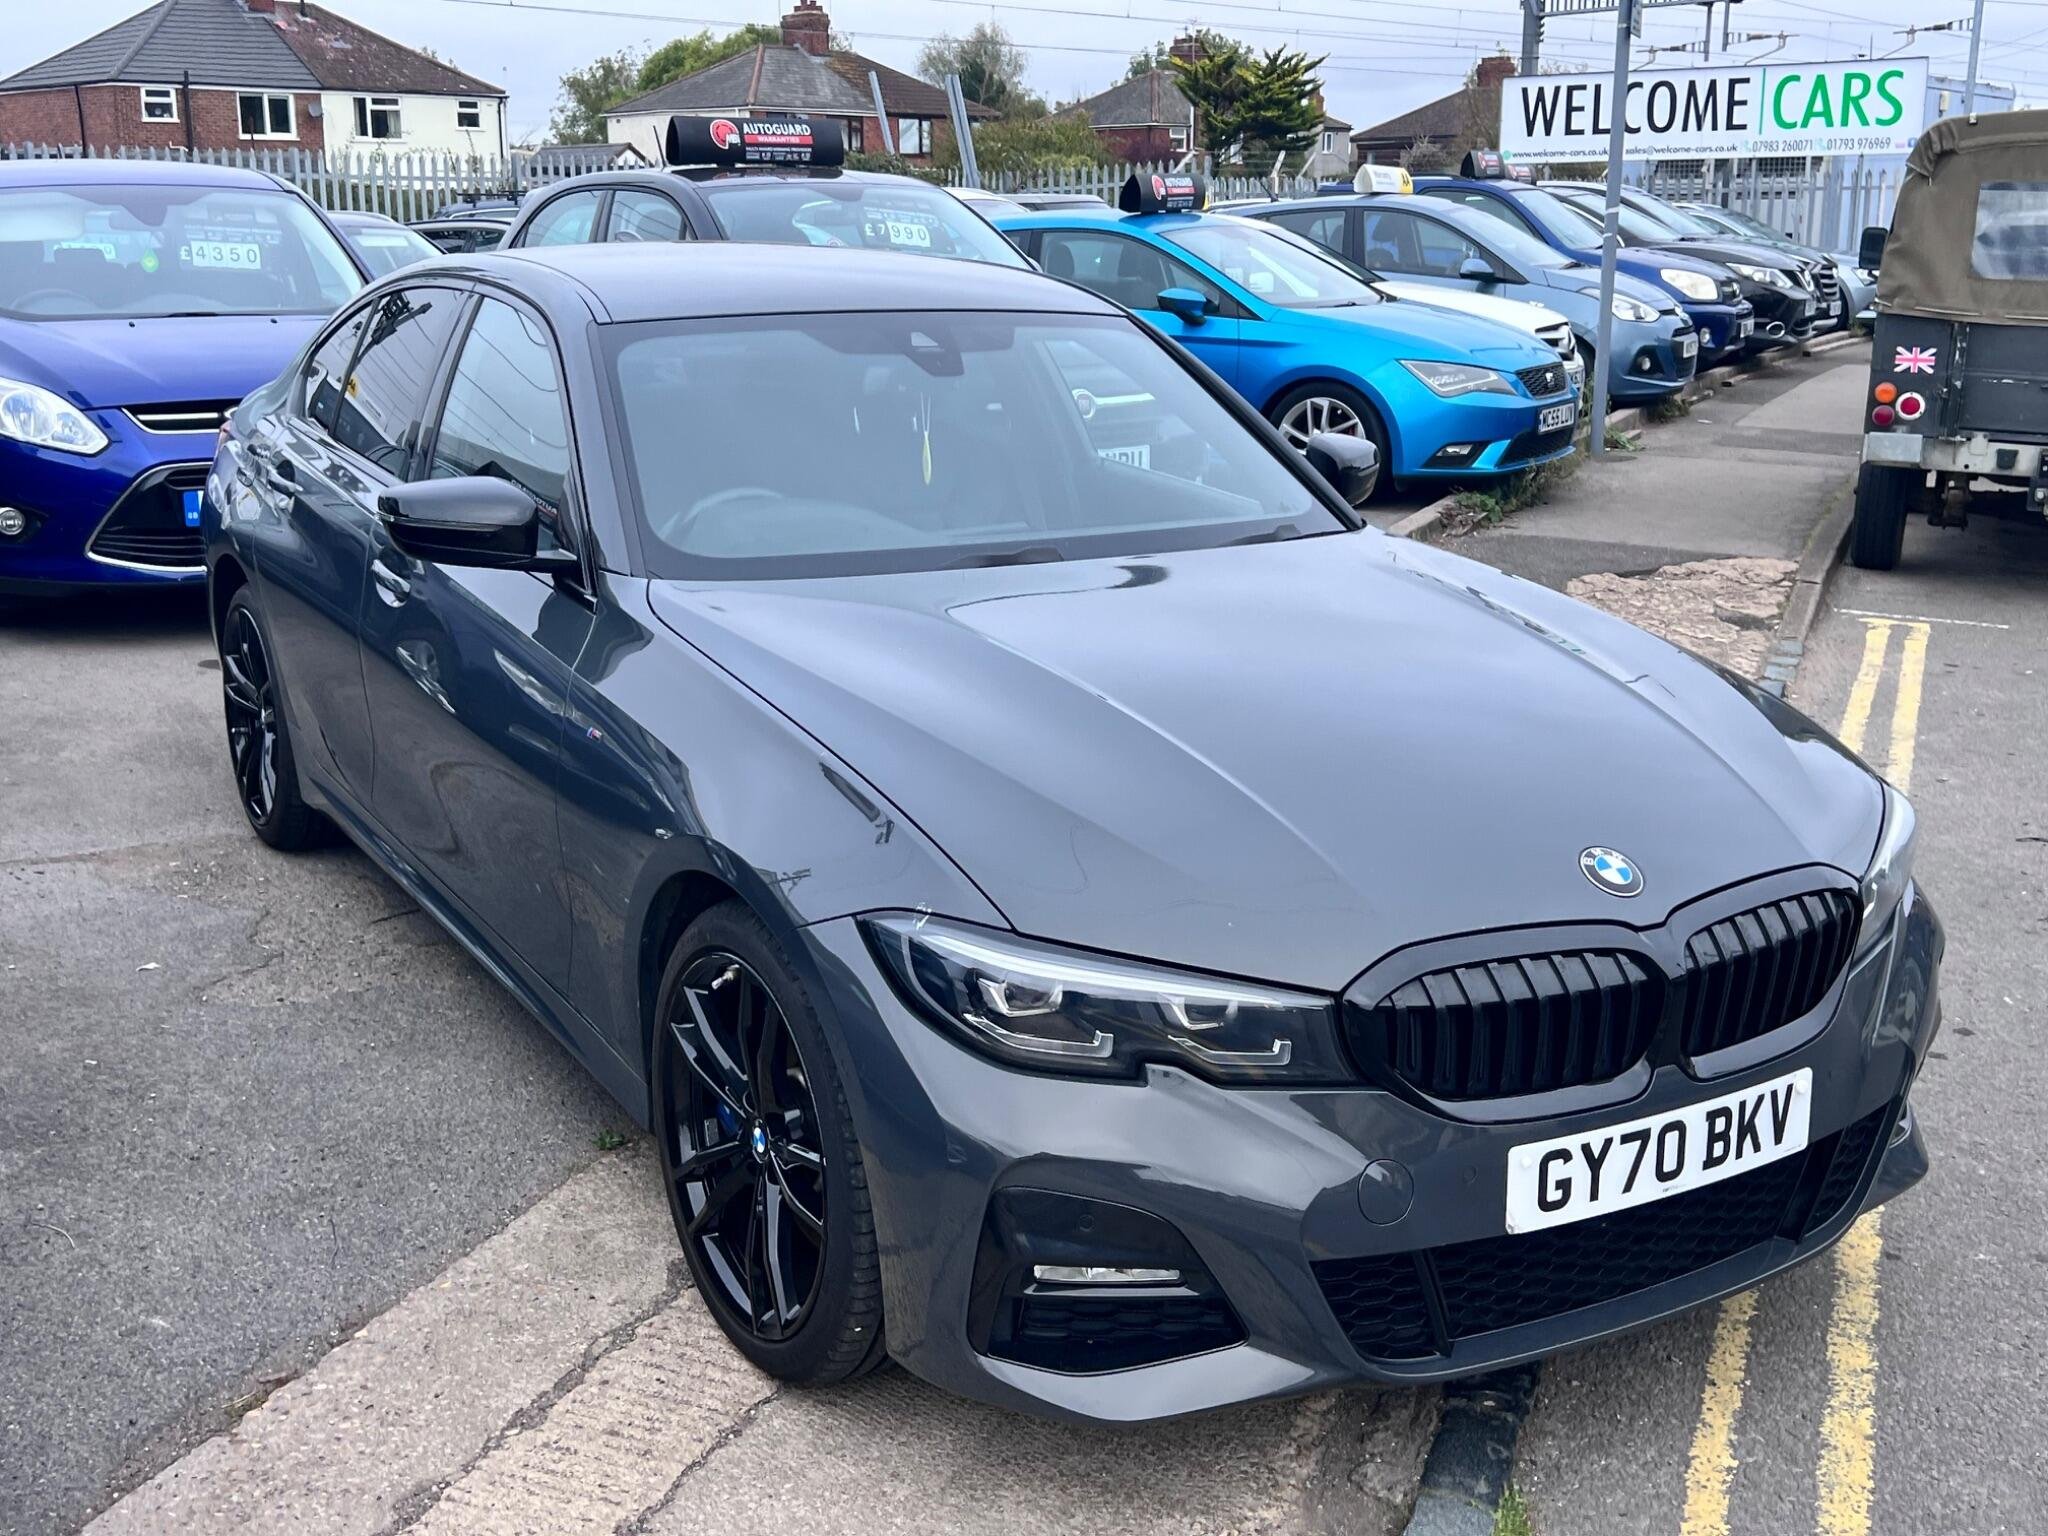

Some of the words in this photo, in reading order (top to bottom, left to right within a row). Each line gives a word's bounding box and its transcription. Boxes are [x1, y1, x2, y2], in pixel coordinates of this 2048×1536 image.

[1521, 78, 1750, 137] WELCOME
[1773, 70, 1904, 129] CARS
[743, 123, 811, 135] AUTOGUARD
[1512, 147, 1608, 158] www.welcome-cars.co.uk
[1752, 140, 1779, 152] 07983
[1782, 139, 1813, 151] 260071
[1827, 138, 1854, 150] 01793
[1857, 137, 1890, 150] 976969
[1538, 1120, 1687, 1213] GY70
[1702, 1083, 1795, 1171] BKV
